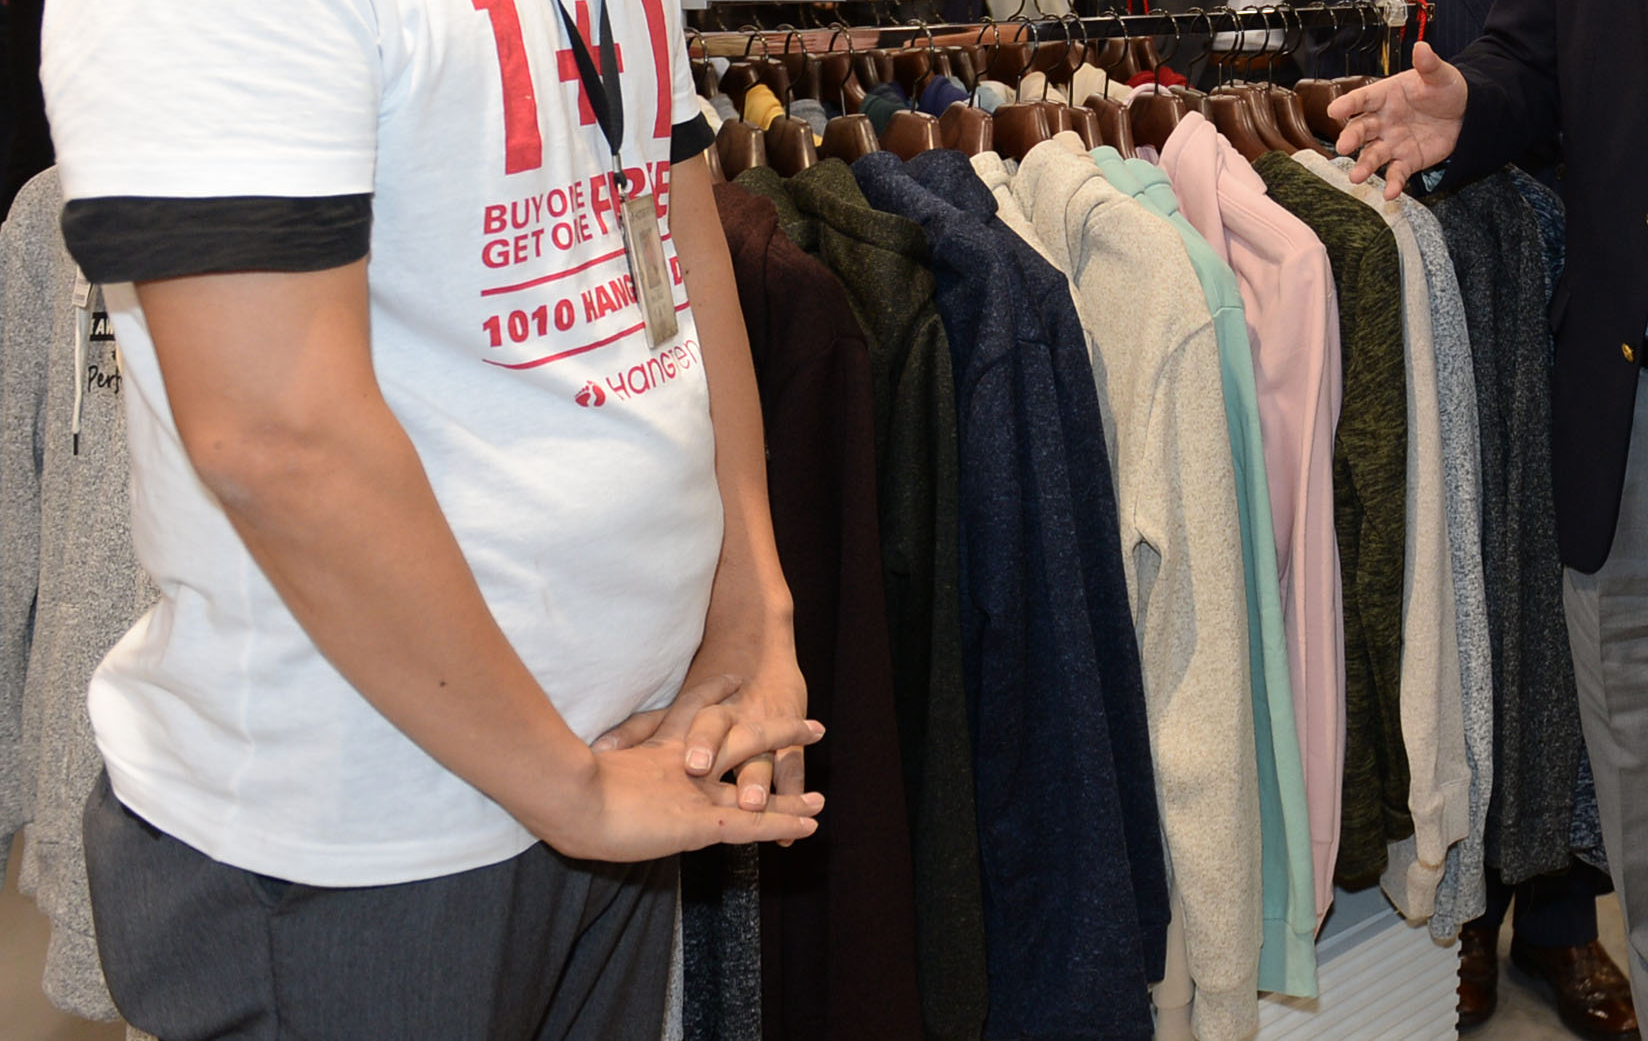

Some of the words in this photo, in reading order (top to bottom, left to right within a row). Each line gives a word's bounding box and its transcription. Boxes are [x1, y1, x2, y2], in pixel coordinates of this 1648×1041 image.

[483, 193, 544, 235] BUY
[480, 228, 545, 269] GET
[482, 298, 576, 348] 1010
